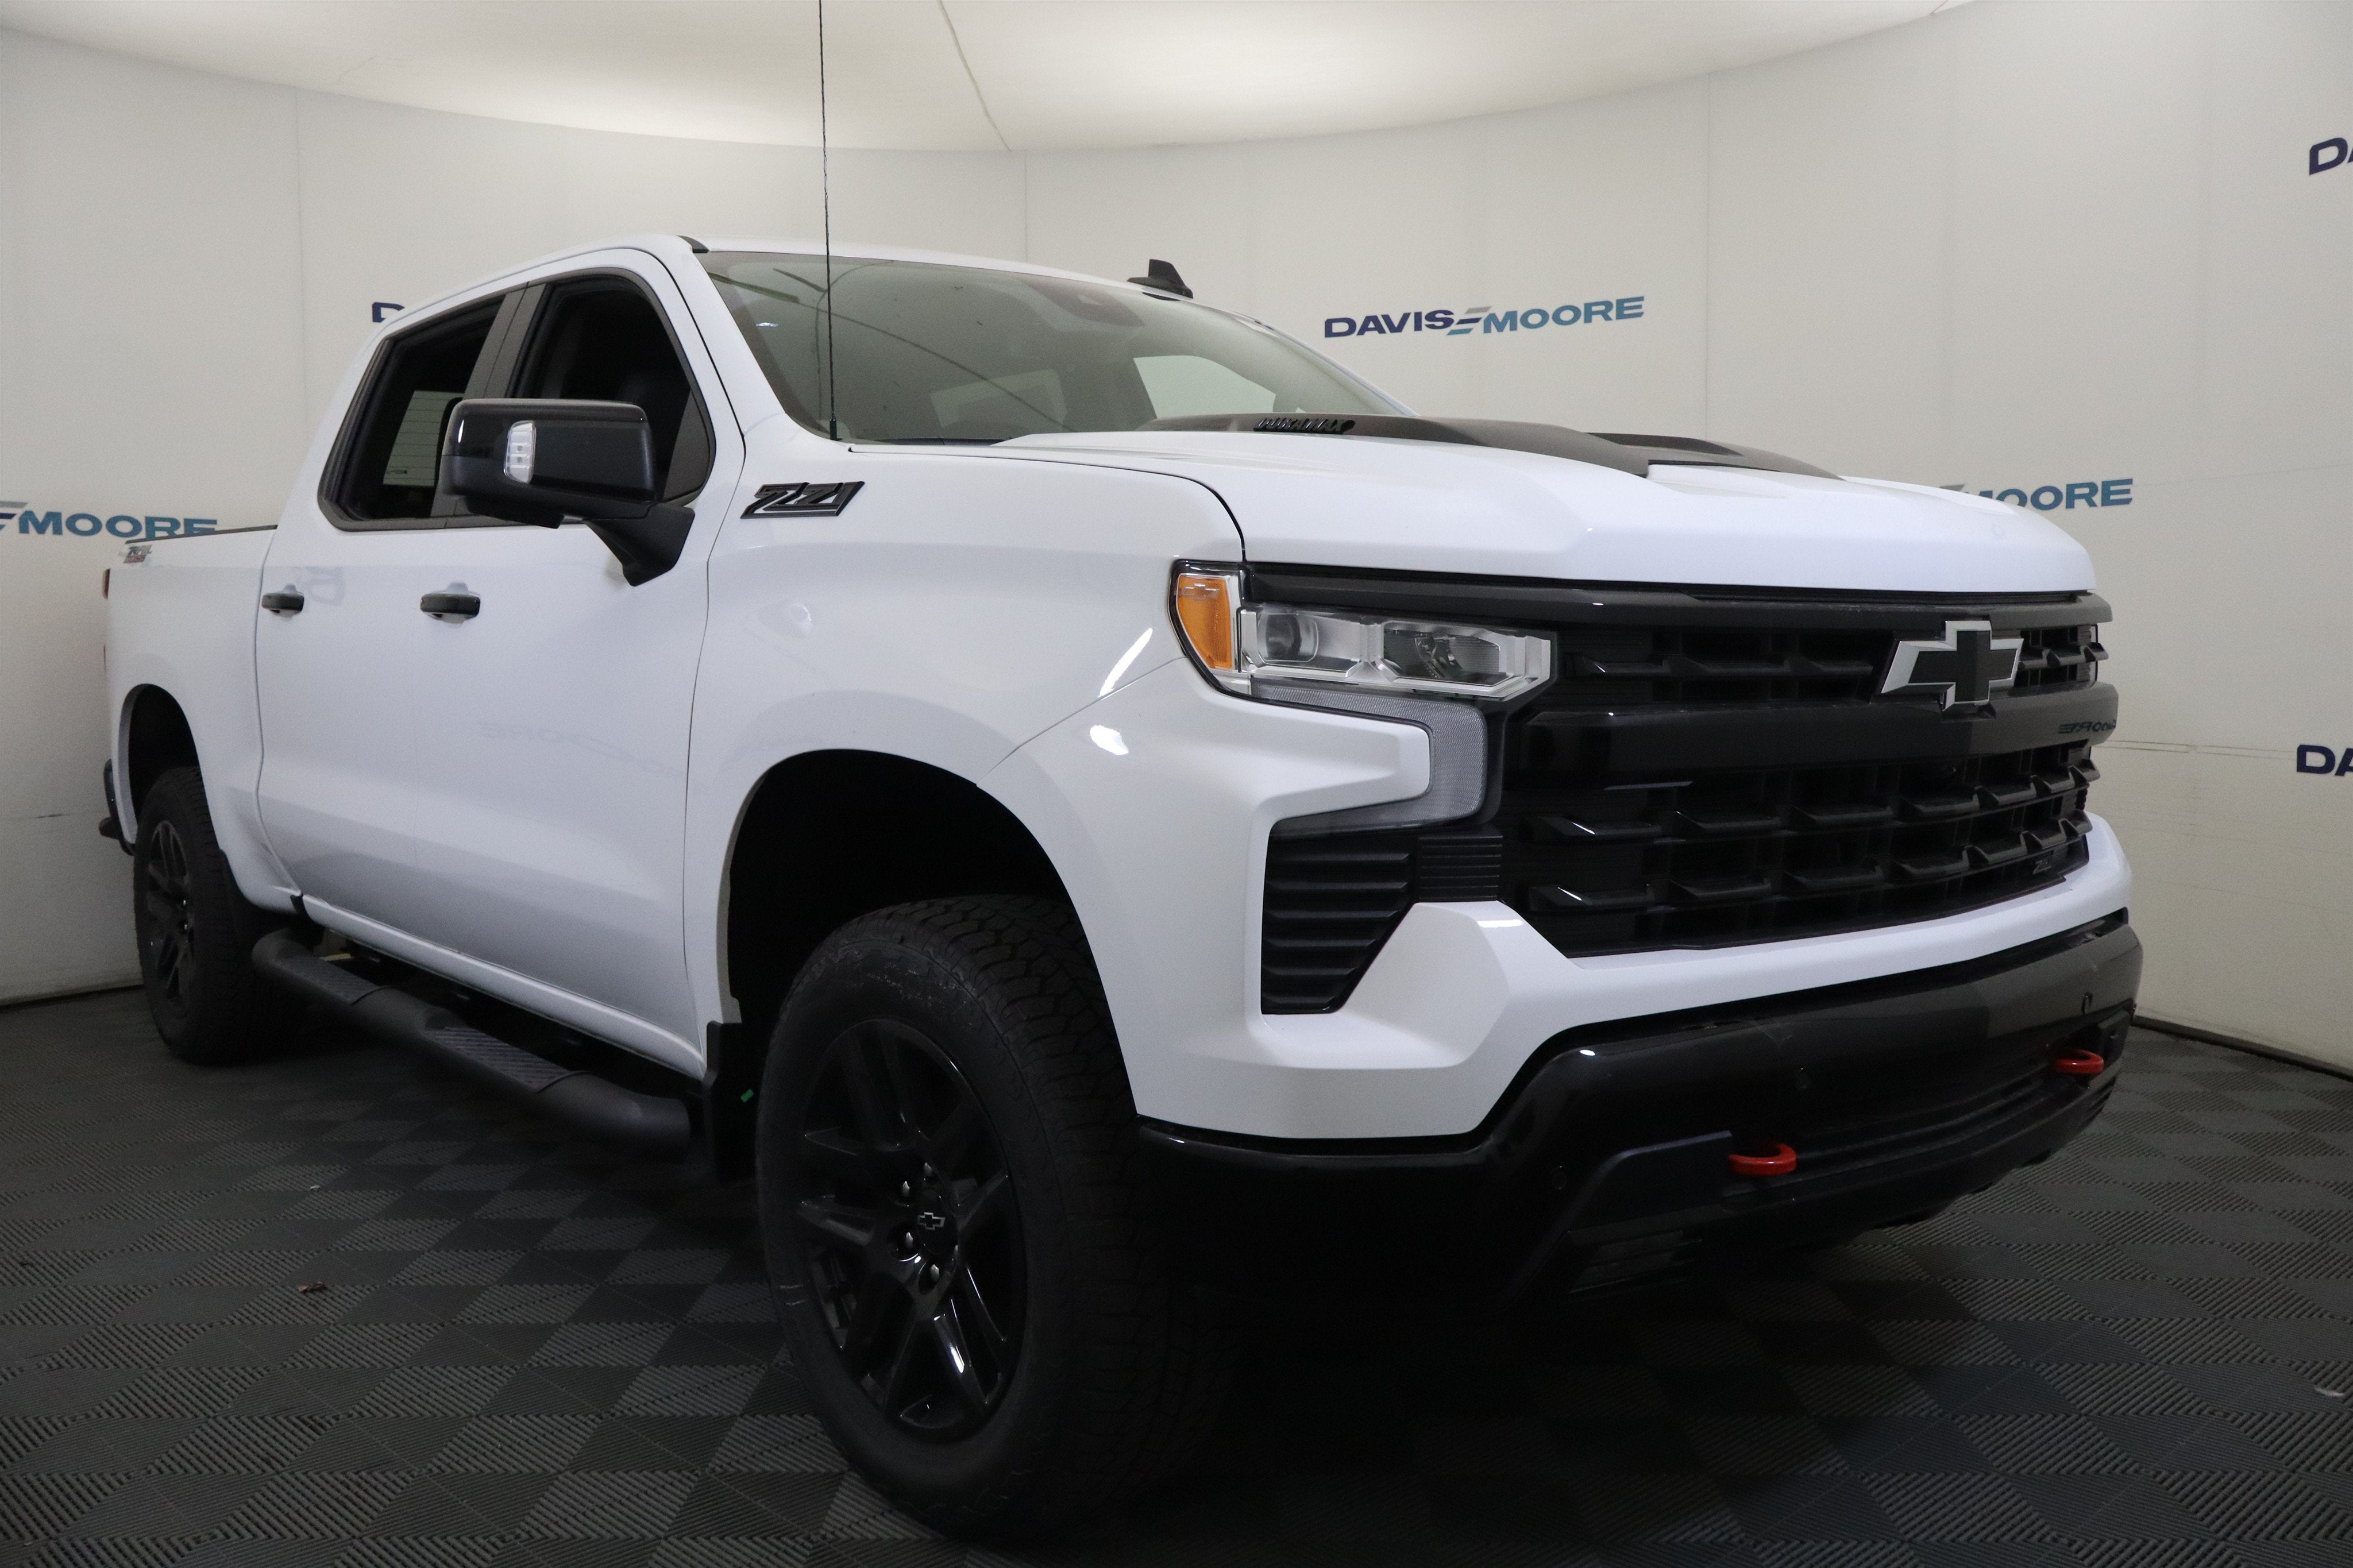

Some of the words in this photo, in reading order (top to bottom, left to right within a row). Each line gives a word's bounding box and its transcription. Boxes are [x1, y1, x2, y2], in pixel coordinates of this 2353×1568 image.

[1324, 310, 1455, 338] DAVIS
[1483, 296, 1645, 334] MOORE
[740, 481, 865, 519] Z71
[1978, 478, 2133, 511] OORE
[18, 510, 217, 539] MOORE
